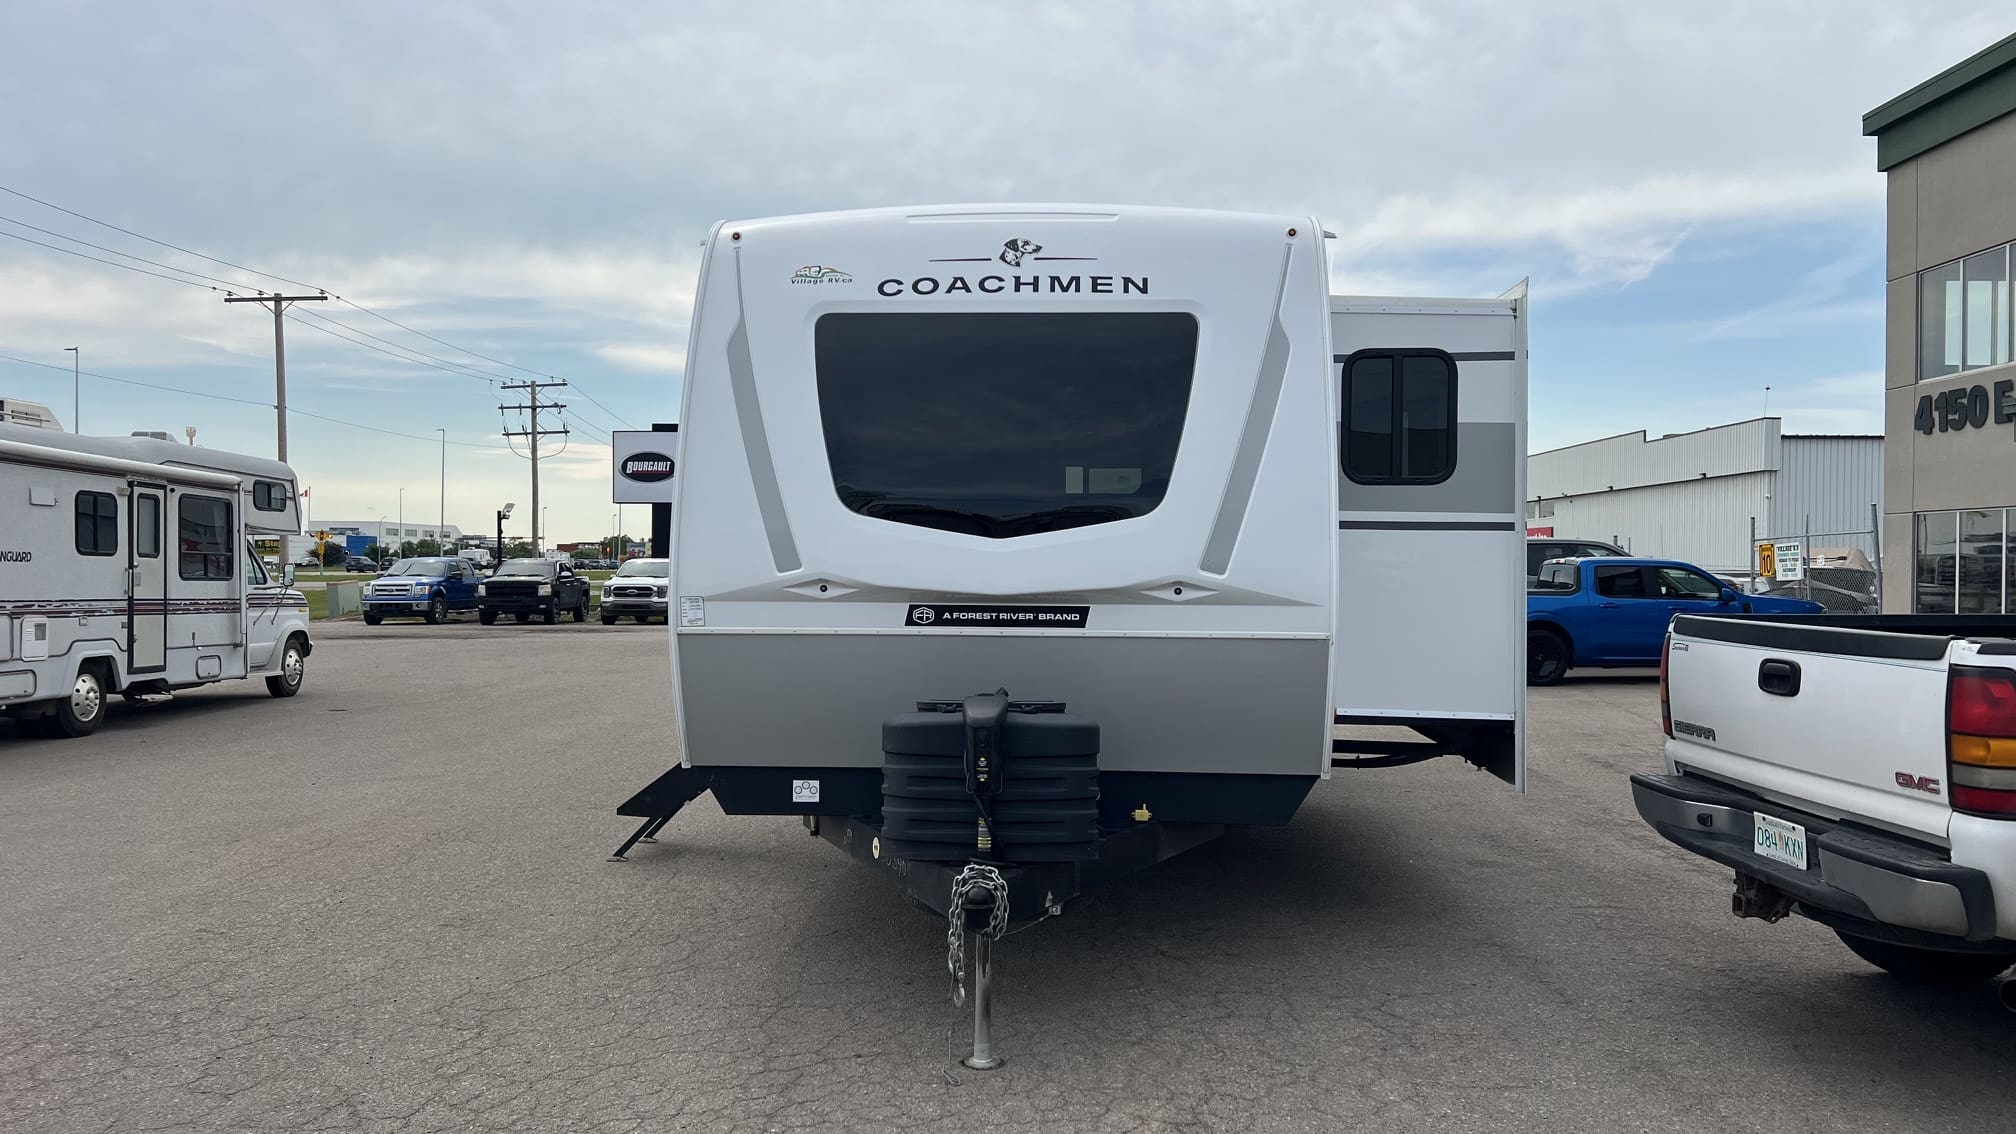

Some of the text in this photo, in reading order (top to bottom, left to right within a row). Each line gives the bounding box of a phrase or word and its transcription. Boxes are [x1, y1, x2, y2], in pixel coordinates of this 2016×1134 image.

[877, 275, 1149, 297] COACHMEN
[1914, 384, 1989, 435] 4150
[626, 461, 671, 474] BOURGAULT
[0, 551, 32, 562] NGUARD
[1763, 554, 1771, 574] 10
[942, 612, 951, 620] A
[952, 612, 998, 620] FOREST
[1038, 613, 1080, 621] BRAND
[1674, 719, 1716, 742] SIERRA
[1895, 771, 1941, 795] GMC
[1783, 834, 1803, 862] KXN
